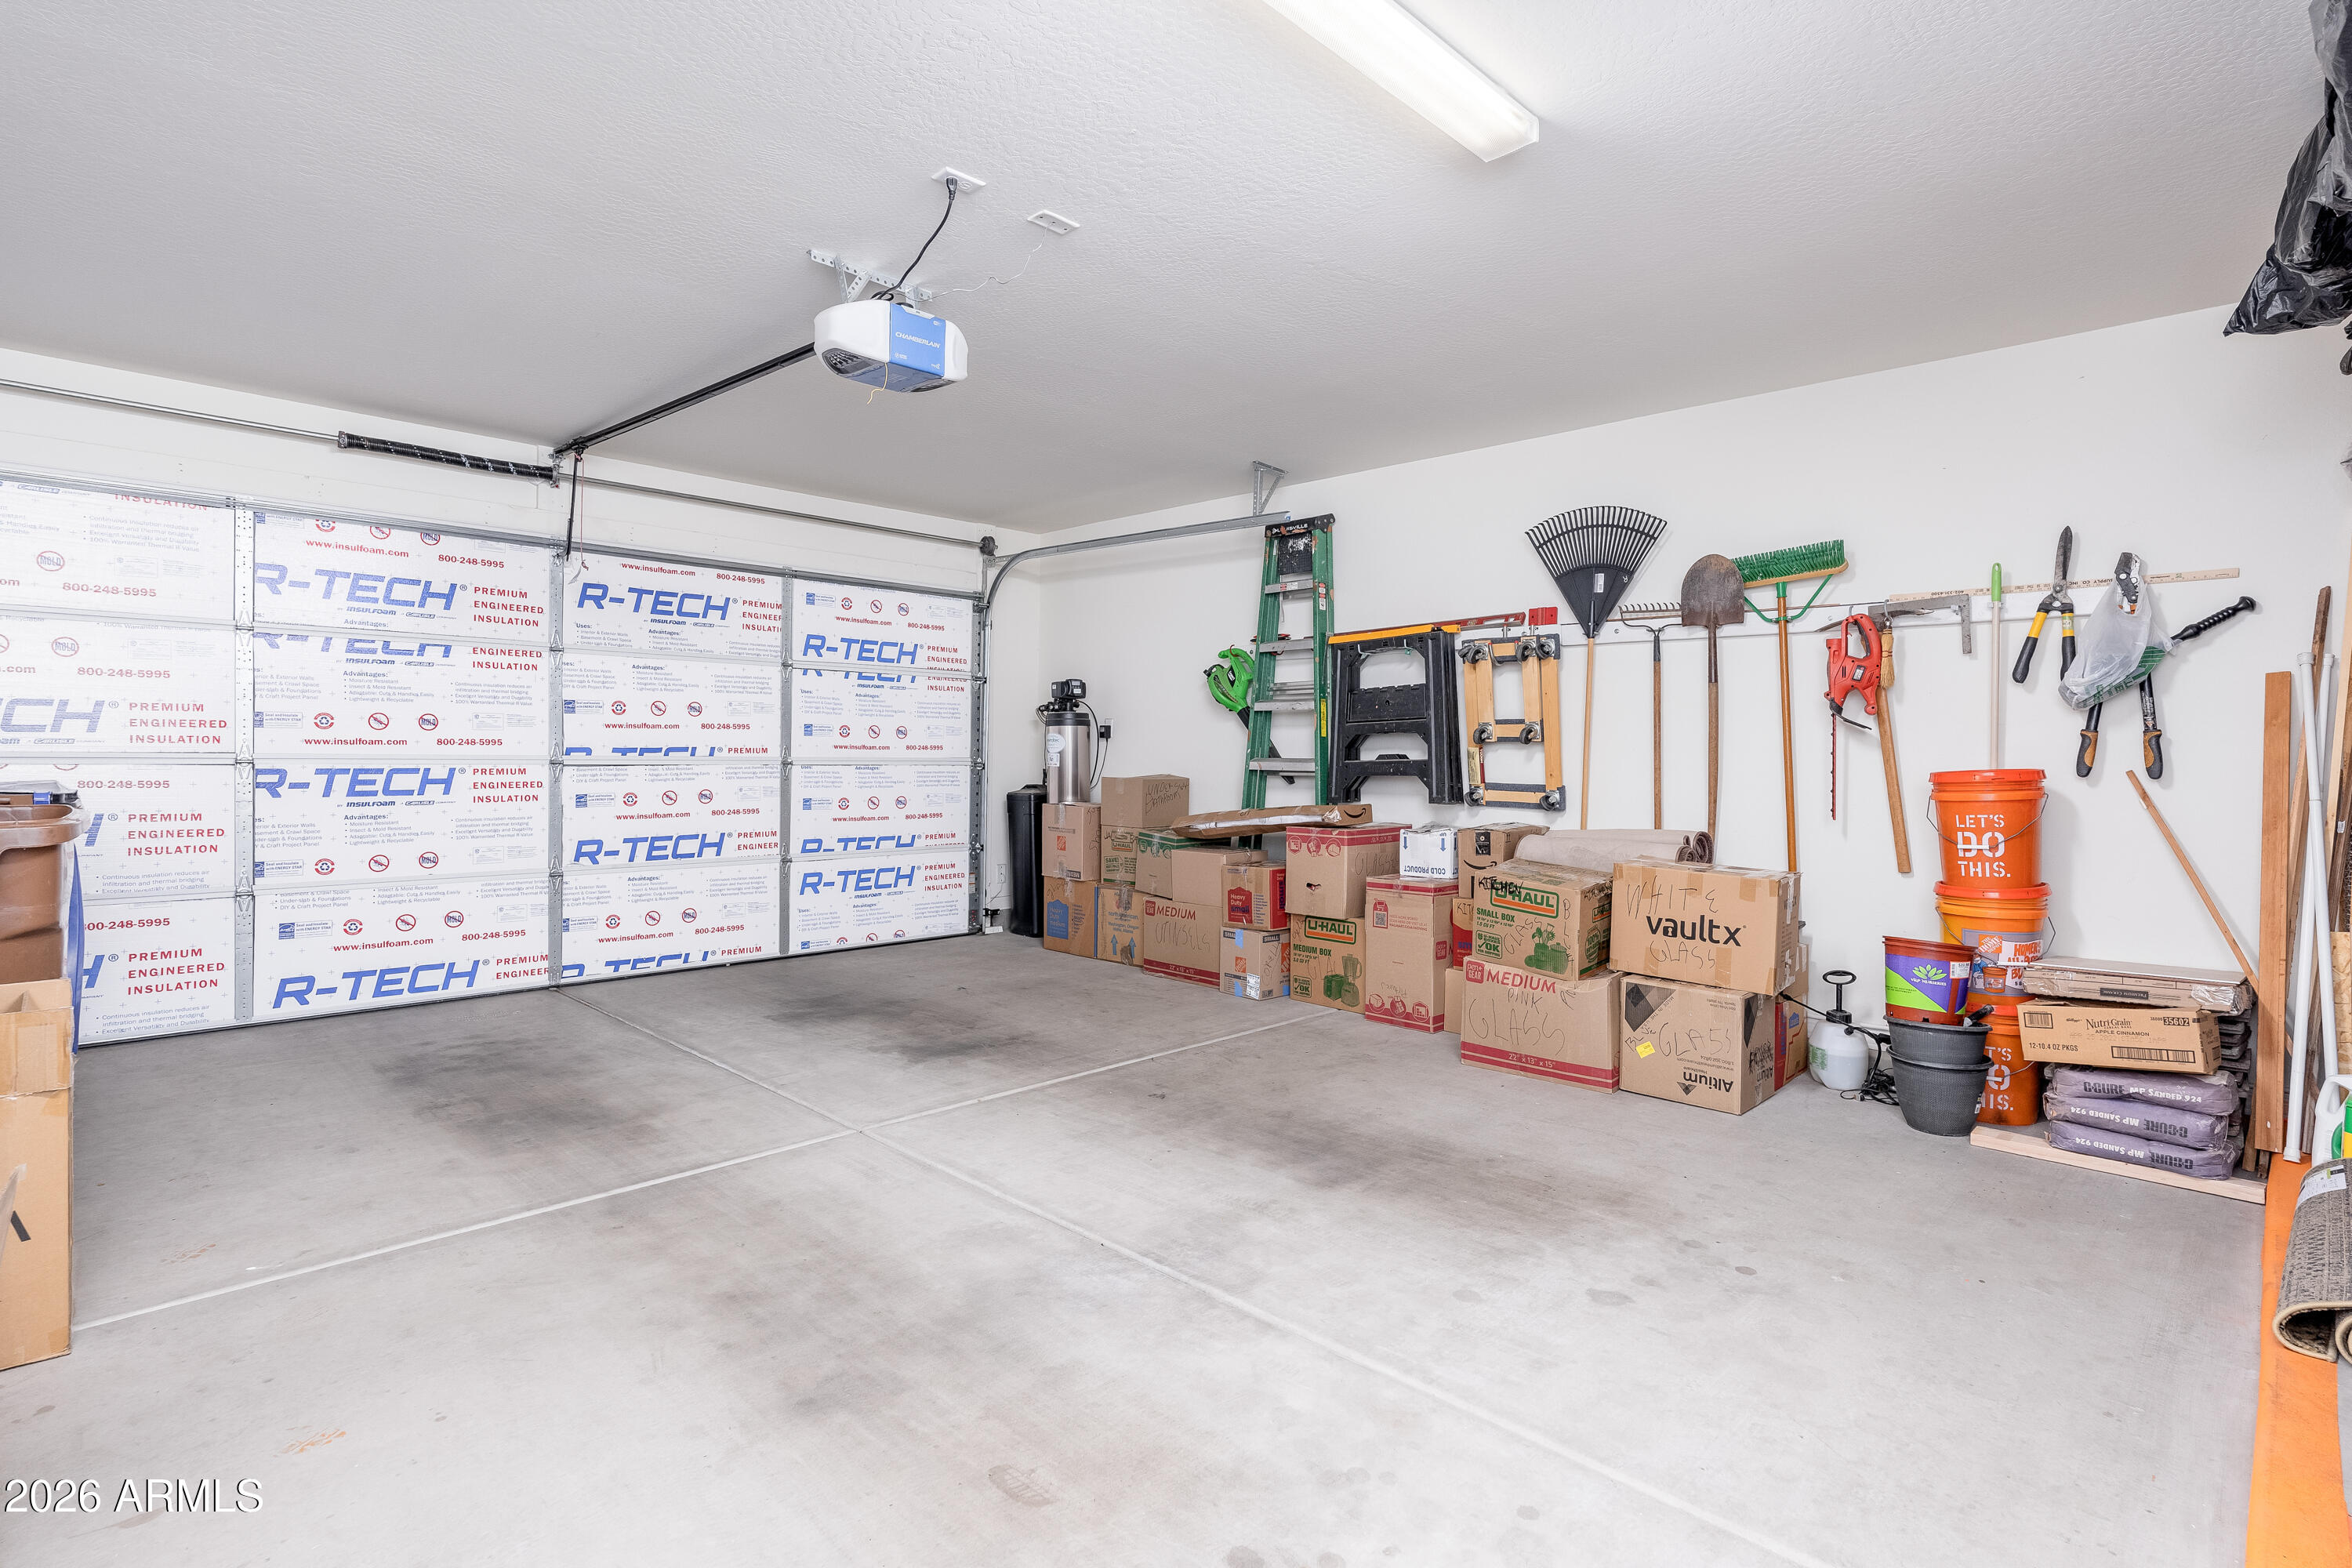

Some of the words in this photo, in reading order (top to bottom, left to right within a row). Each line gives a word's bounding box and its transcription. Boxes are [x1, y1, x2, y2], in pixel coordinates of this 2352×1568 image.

[895, 332, 940, 349] CHAMBERLAIN
[306, 540, 409, 557] www.insulfoam.com
[438, 554, 505, 568] 800-248-5995
[622, 564, 695, 576] www.insulfoam.com
[717, 573, 765, 584] 800-248-5995
[63, 582, 157, 597] 800-248-5995
[254, 562, 458, 611] R-TECH
[474, 586, 528, 599] PREMIUM
[474, 601, 544, 614] ENGINEERED
[577, 583, 731, 620] R-TECH
[742, 600, 782, 609] PREMIUM
[344, 618, 389, 628] Advantages:
[474, 615, 539, 627] INSULATION
[836, 616, 891, 626] www.insulfoam.com
[472, 647, 543, 659] ENGINEERED
[802, 634, 918, 665] R-TECH
[473, 661, 538, 671] INSULATION
[927, 655, 967, 664] ENGINEERED
[77, 666, 171, 679] 800-248-5995
[343, 670, 388, 679] Advantages:
[129, 703, 205, 712] PREMIUM
[129, 719, 227, 728] ENGINEERED
[130, 735, 220, 744] INSULATION
[437, 738, 503, 746] 800-248-5995
[473, 768, 527, 776] PREMIUM
[77, 780, 170, 789] 800-248-5995
[254, 767, 456, 798] R-TECH
[473, 781, 543, 789] ENGINEERED
[473, 794, 539, 803] INSULATION
[128, 813, 202, 822] PREMIUM
[616, 811, 691, 820] www.insulfoam.com
[1955, 814, 2005, 829] LET'S
[128, 828, 225, 839] ENGINEERED
[128, 844, 218, 856] INSULATION
[573, 832, 726, 865] R-TECH
[1957, 831, 2005, 858] DO
[1403, 865, 1429, 873] PRODUCT
[1958, 860, 2011, 878] THIS.
[800, 866, 916, 895] R-TECH
[924, 873, 964, 881] ENGINEERED
[1478, 876, 1524, 895] KITCHEN
[1156, 906, 1196, 920] MEDIUM
[1476, 907, 1499, 920] SMALL
[1501, 913, 1515, 923] BOX
[84, 917, 170, 931] 00-248-5995
[695, 924, 745, 935] 800-248-5995
[1308, 919, 1353, 935] U-HAUL
[1646, 914, 1742, 947] vaultx
[462, 929, 526, 942] 800-248-5995
[598, 932, 673, 943] www.insulfoam.com
[333, 939, 434, 952] www.insulfoam.com
[1293, 943, 1318, 955] MEDIUM
[1319, 948, 1332, 957] BOX
[1485, 942, 1500, 953] OK
[1979, 935, 2002, 953] HOME
[129, 948, 202, 962] PREMIUM
[721, 946, 762, 956] PREMIUM
[1650, 939, 1716, 969] GLASS
[496, 954, 549, 966] PREMIUM
[128, 962, 225, 979] ENGINEERED
[1468, 971, 1482, 982] GEAR
[128, 979, 219, 995] INSULATION
[272, 960, 480, 1009] R-TECH
[1486, 968, 1556, 994] MEDIUM
[1508, 987, 1543, 1014] PINK
[102, 1012, 140, 1021] Continuous
[2164, 1017, 2189, 1026] 35602
[1468, 997, 1566, 1057] GLASS
[1658, 1022, 1732, 1057] GLASS
[1545, 1060, 1556, 1069] 15"
[1682, 1066, 1708, 1075] Healthcare
[1682, 1071, 1734, 1093] Altium
[2147, 1088, 2183, 1101] SANDED
[2184, 1094, 2202, 1103] 924
[2070, 1106, 2087, 1115] 924
[2089, 1110, 2121, 1123] SANDED
[2122, 1117, 2140, 1127] MP
[2075, 1137, 2091, 1146] 924
[2093, 1142, 2125, 1155] SANDED
[2127, 1149, 2145, 1159] MP
